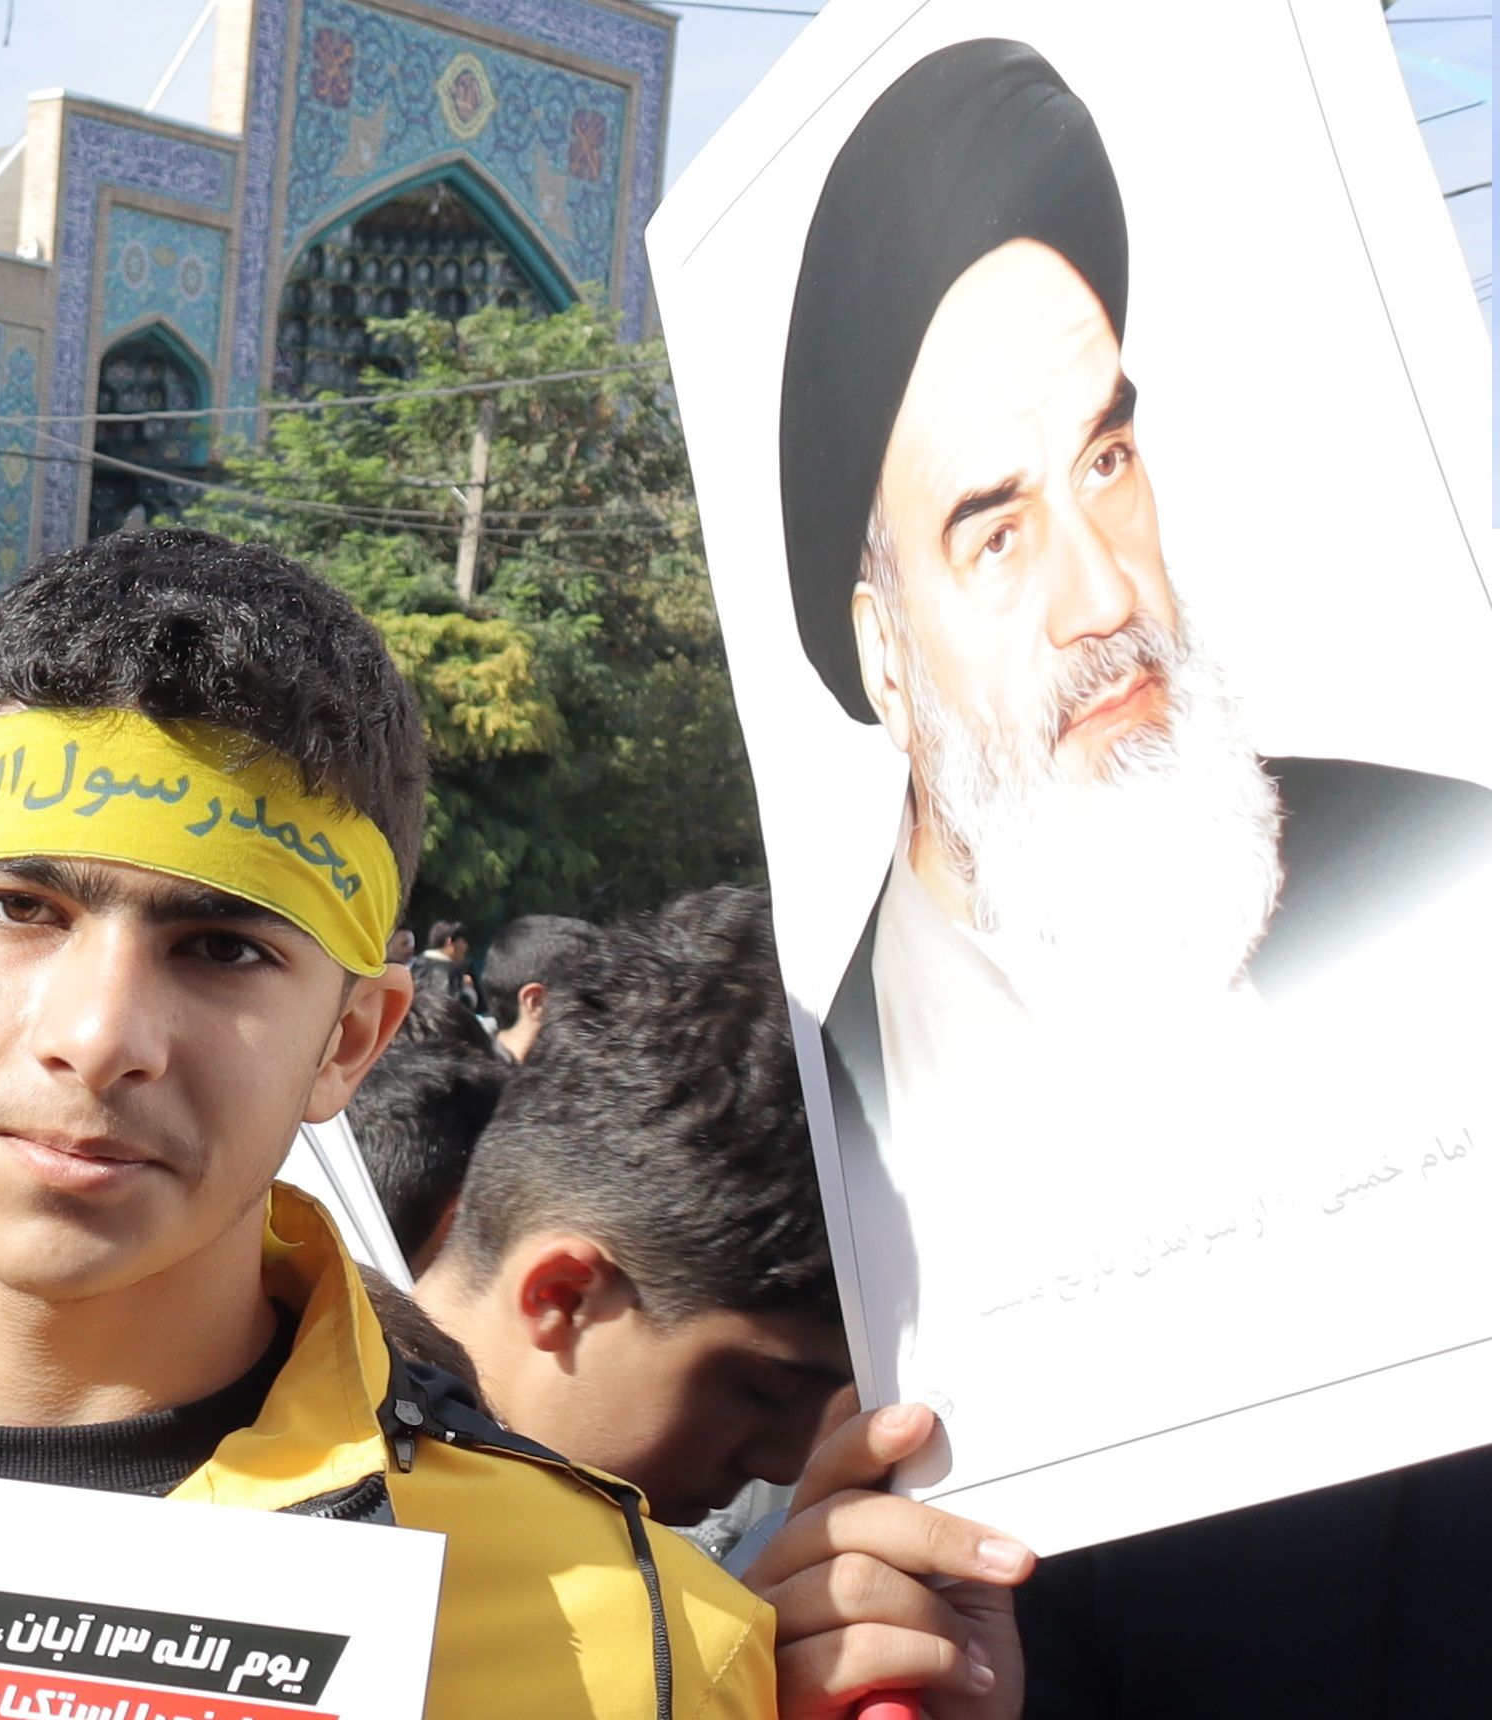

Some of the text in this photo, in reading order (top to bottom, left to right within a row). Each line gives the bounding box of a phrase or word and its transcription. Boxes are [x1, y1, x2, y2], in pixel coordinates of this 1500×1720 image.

[23, 741, 223, 838] رسول
[231, 796, 362, 901] محمد
[1321, 1154, 1404, 1216] خمینی
[1420, 1127, 1476, 1182] امام
[226, 1652, 312, 1694] یوم
